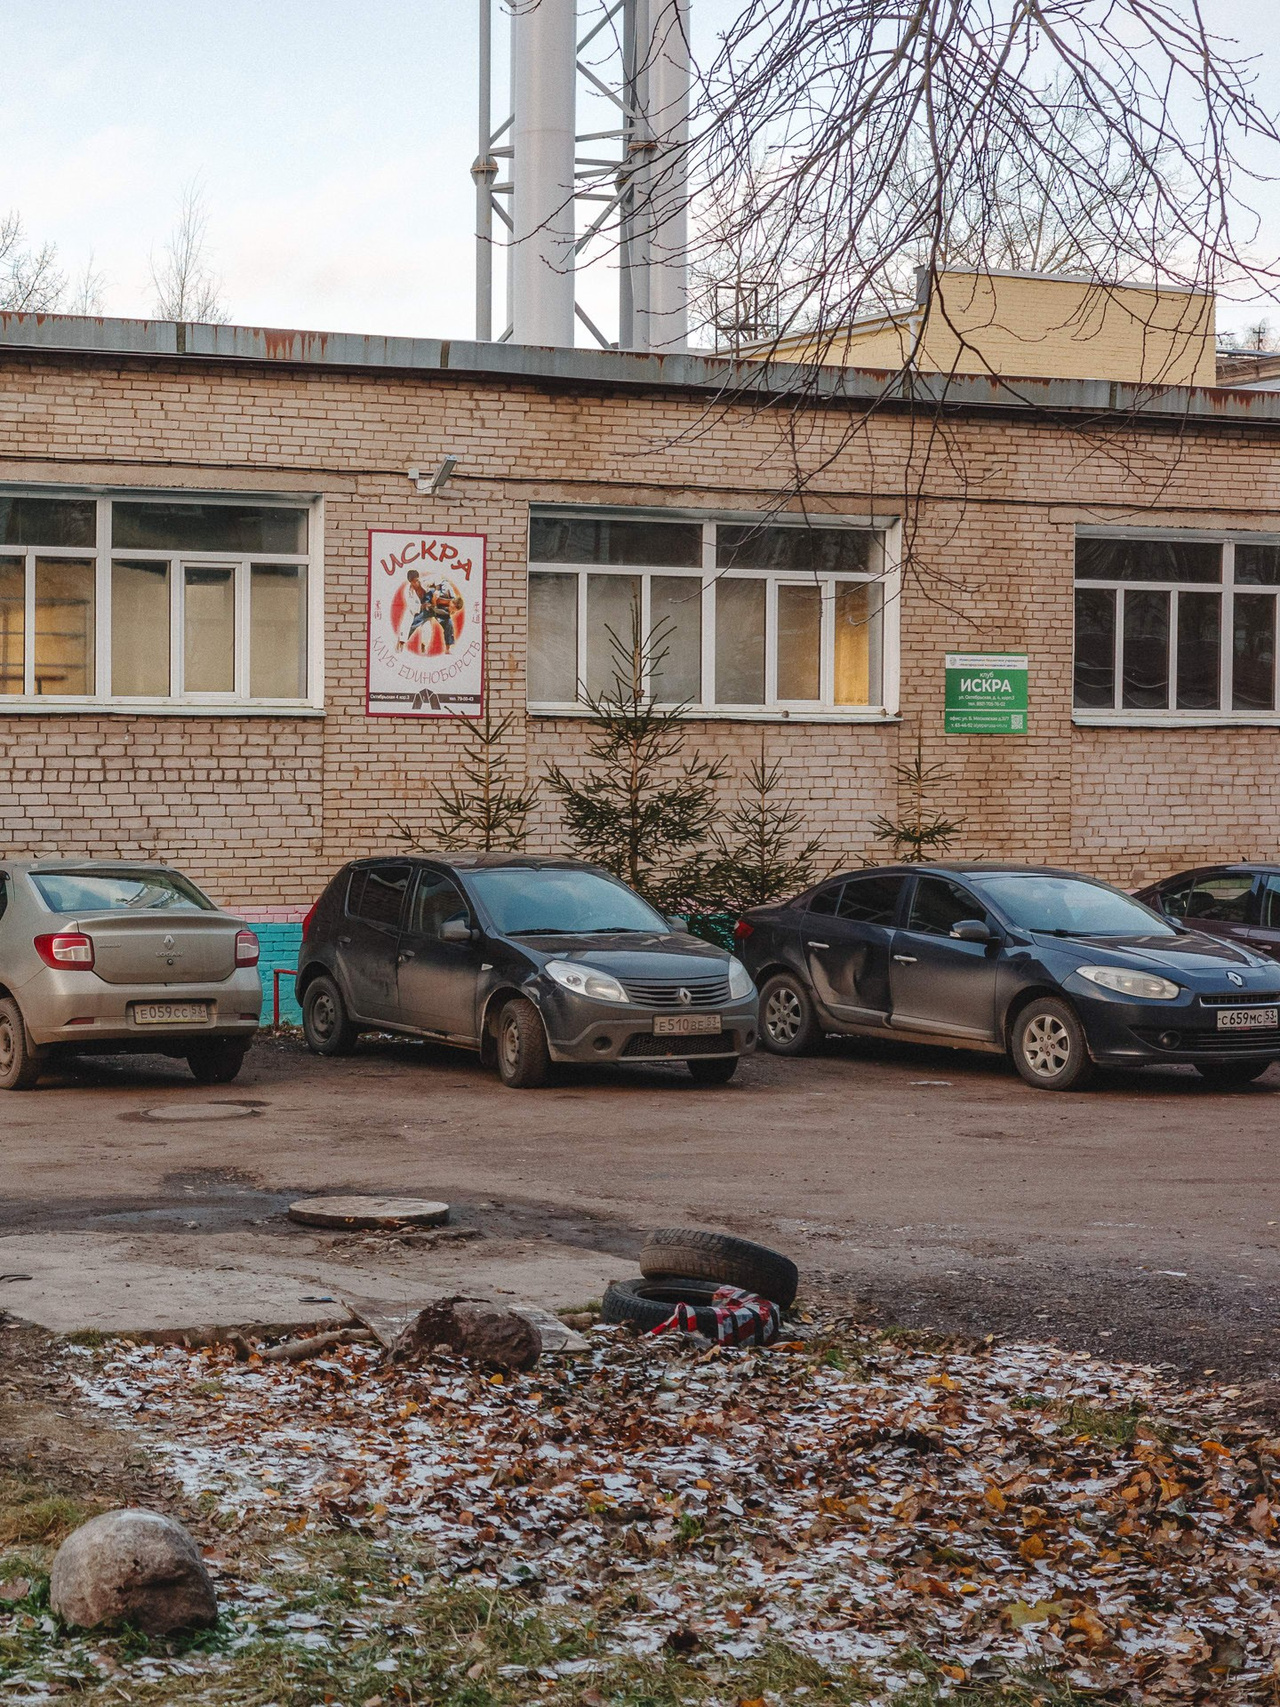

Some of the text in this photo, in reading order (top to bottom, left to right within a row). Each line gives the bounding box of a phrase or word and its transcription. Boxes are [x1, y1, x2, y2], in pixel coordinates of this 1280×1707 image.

[380, 540, 472, 581] ИСКРА
[372, 636, 481, 684] КЛУБ ЕДИНОБОРСТВ
[961, 679, 1012, 692] ИСКРА
[979, 671, 994, 679] клуб
